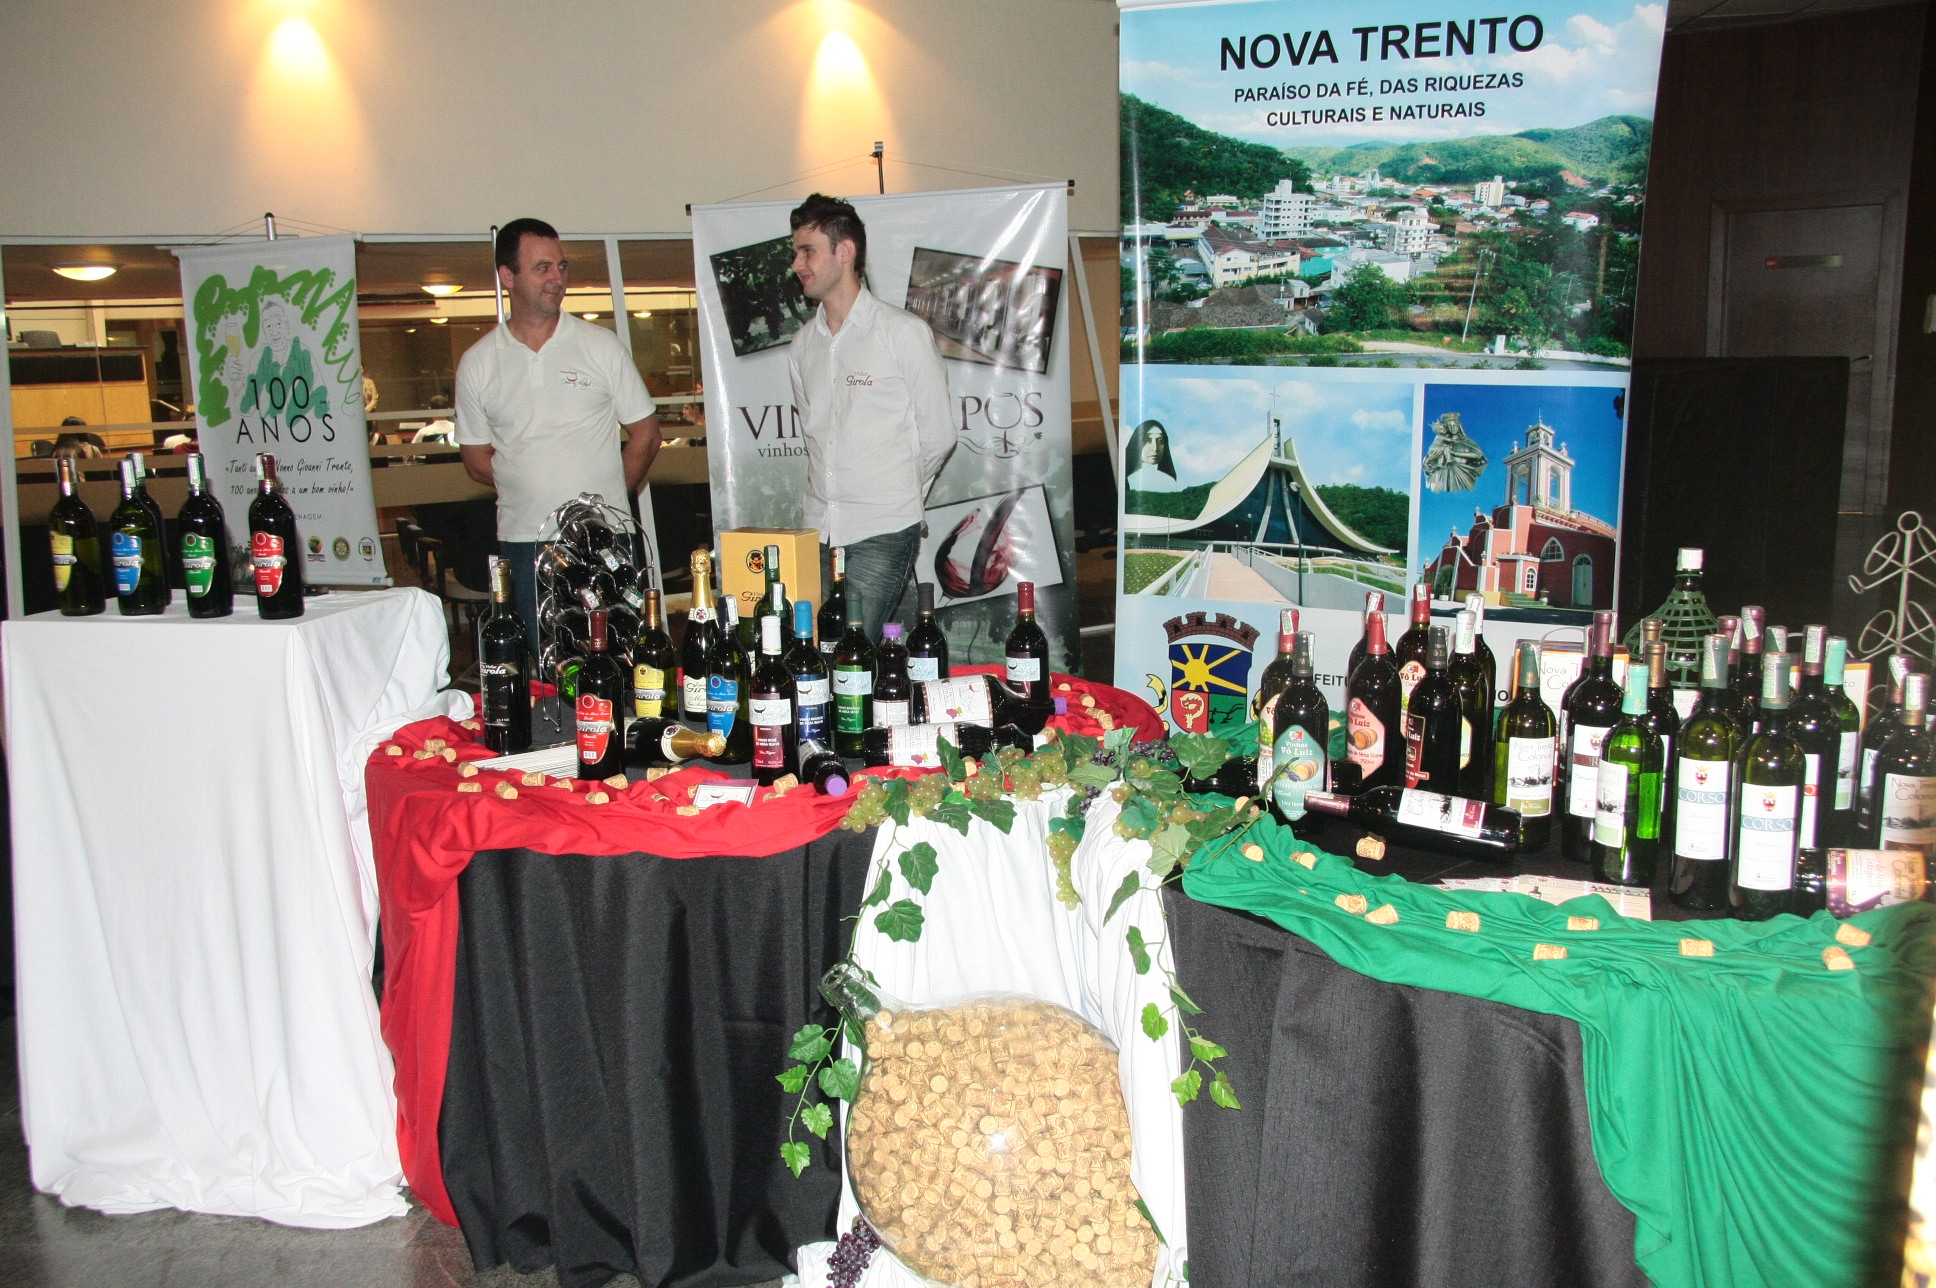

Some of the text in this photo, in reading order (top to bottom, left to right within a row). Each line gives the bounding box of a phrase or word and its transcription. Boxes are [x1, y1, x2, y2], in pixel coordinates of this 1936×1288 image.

[1219, 14, 1544, 71] NOVA TRENTO
[1234, 71, 1524, 103] PARAÍSO DA FÉ, DAS RIQUEZAS
[1266, 101, 1486, 127] CULTURAIS E NATURAIS
[846, 375, 873, 386] Girola
[250, 376, 310, 411] 100
[236, 413, 336, 444] ANOS
[326, 457, 354, 474] Trento,
[231, 484, 244, 494] 100
[311, 484, 325, 494] bom
[294, 513, 325, 521] ENAGEM:
[115, 558, 140, 568] irola
[740, 591, 761, 602] Gir
[1411, 673, 1422, 682] Lu
[1354, 717, 1371, 727] Luiz
[1408, 730, 1421, 741] Luiz
[1281, 746, 1313, 756] Vô Luiz
[1573, 754, 1599, 767] COR
[1891, 776, 1915, 789] Nova
[1680, 789, 1726, 804] CORSO
[1742, 816, 1794, 831] CORSO
